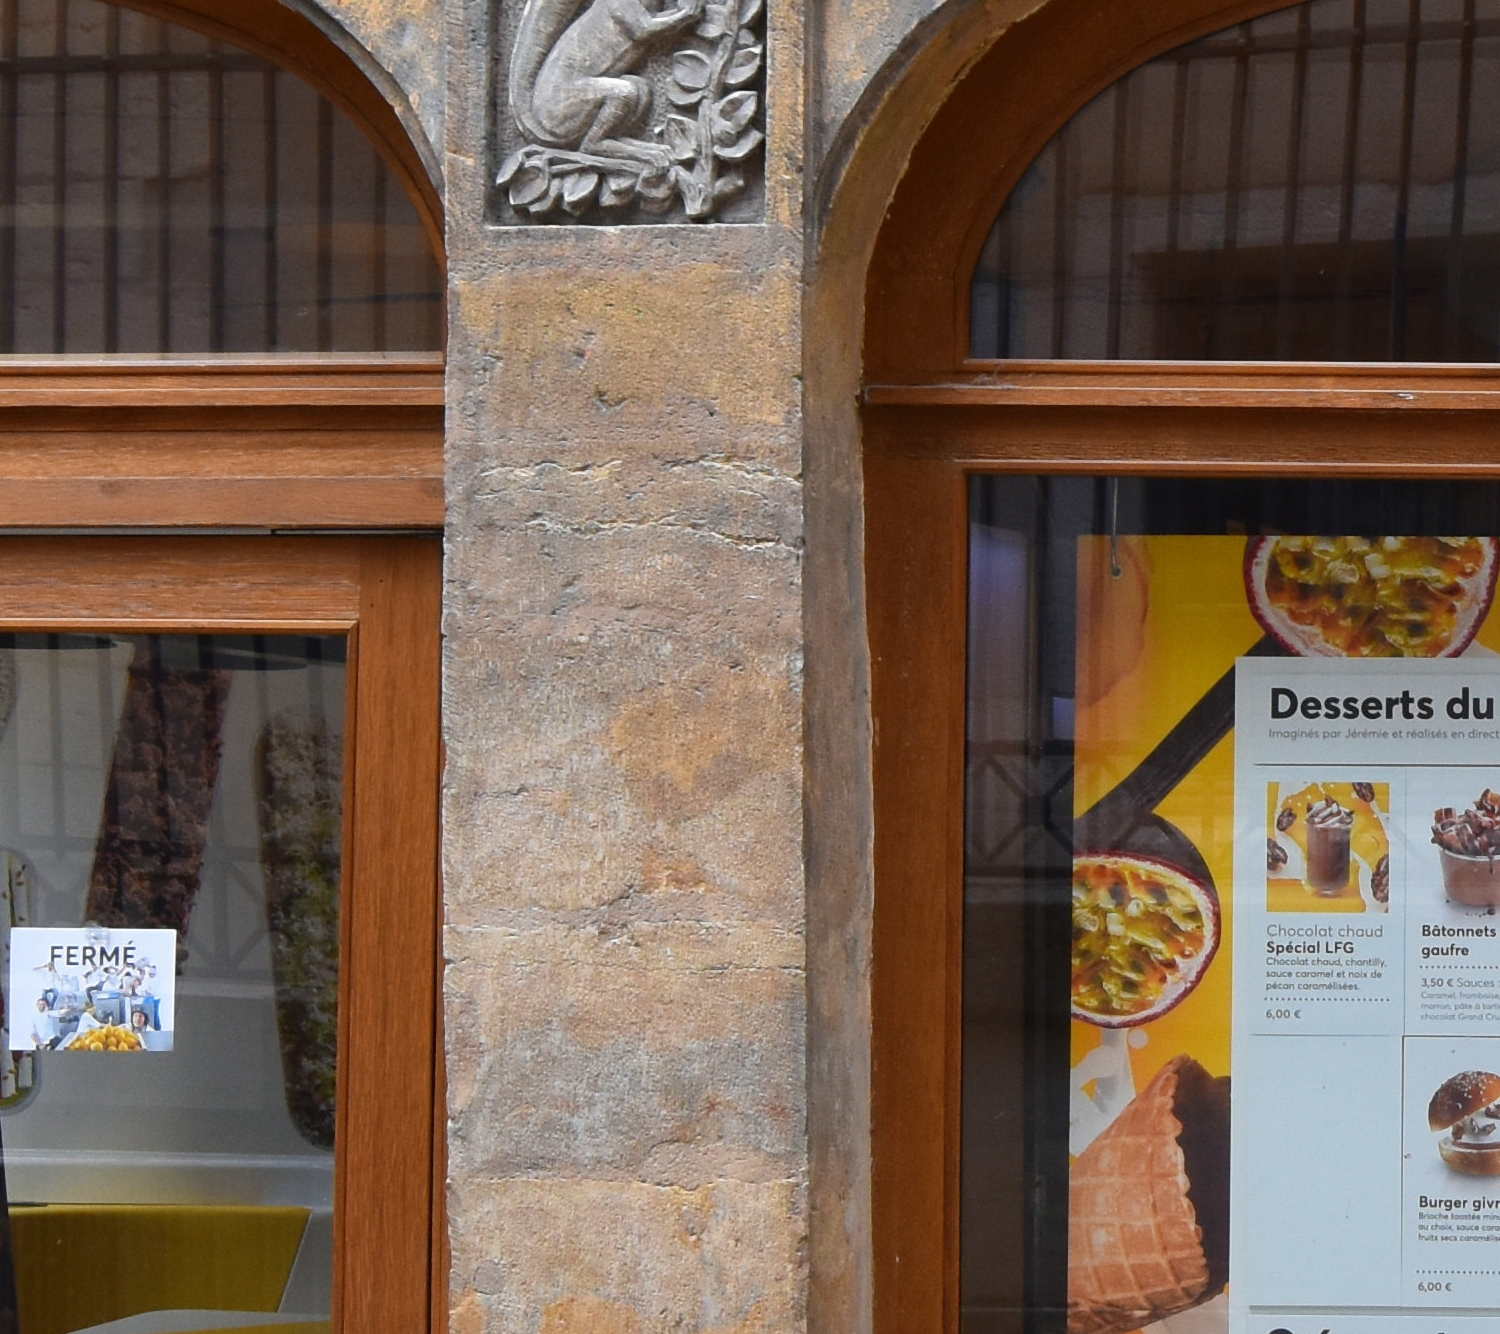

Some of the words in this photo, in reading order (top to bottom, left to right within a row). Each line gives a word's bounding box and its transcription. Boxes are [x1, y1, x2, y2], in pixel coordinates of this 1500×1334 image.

[1271, 688, 1434, 719] Desserts
[1446, 687, 1493, 719] du
[1266, 923, 1333, 938] Chocolat
[1337, 924, 1384, 938] chaud
[1421, 924, 1497, 938] Bâtonnets
[50, 940, 137, 969] FERMÉ
[1266, 940, 1321, 957] Spécial
[1325, 940, 1355, 954] LFG
[1421, 942, 1470, 960] gaufre
[1265, 1008, 1291, 1021] 6,00
[1293, 1009, 1301, 1020] €
[1419, 1195, 1469, 1212] Burger
